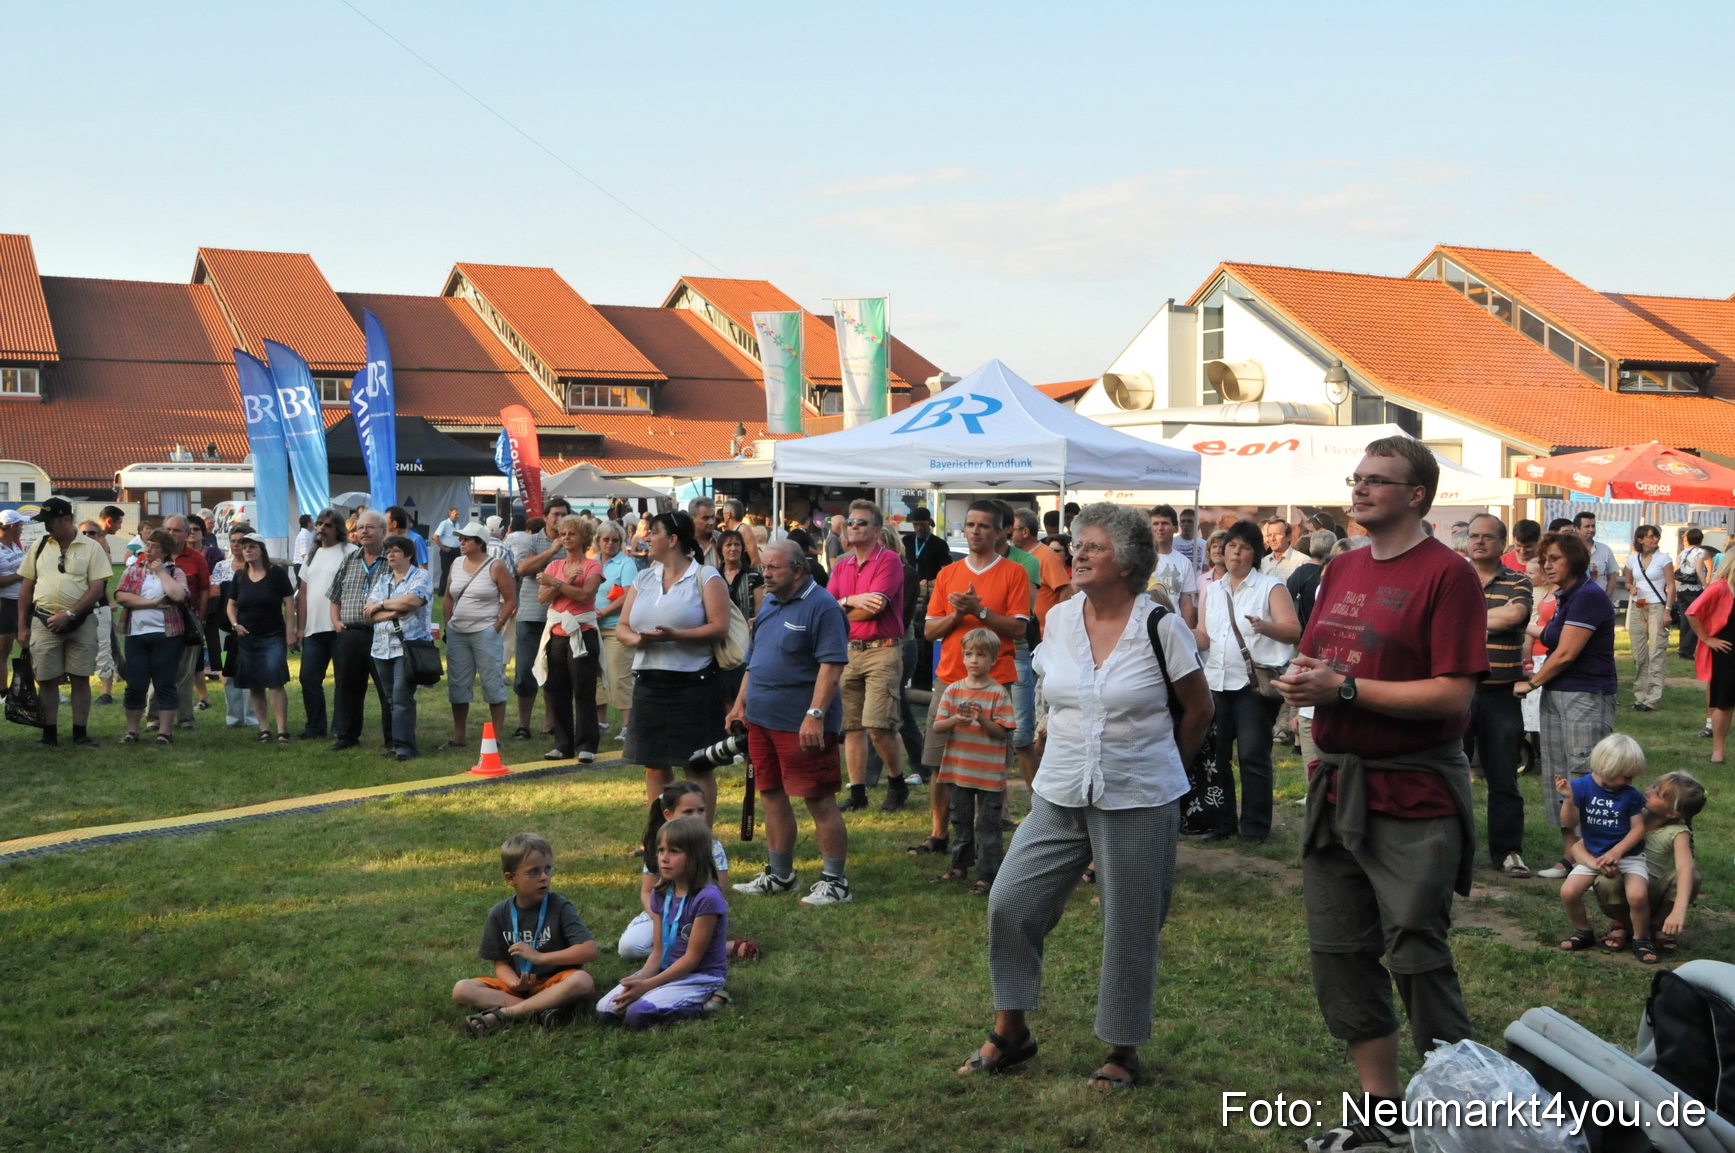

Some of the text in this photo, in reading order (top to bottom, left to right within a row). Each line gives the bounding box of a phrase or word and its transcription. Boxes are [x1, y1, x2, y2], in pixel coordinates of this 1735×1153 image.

[367, 360, 391, 398] BR
[243, 394, 279, 424] BR
[277, 386, 316, 419] BR
[890, 393, 1003, 434] BR
[930, 458, 1033, 472] Bayerischer Rundfunk
[1585, 807, 1619, 818] WAR'S
[1591, 796, 1614, 808] ICH
[1586, 816, 1619, 828] NICHT!
